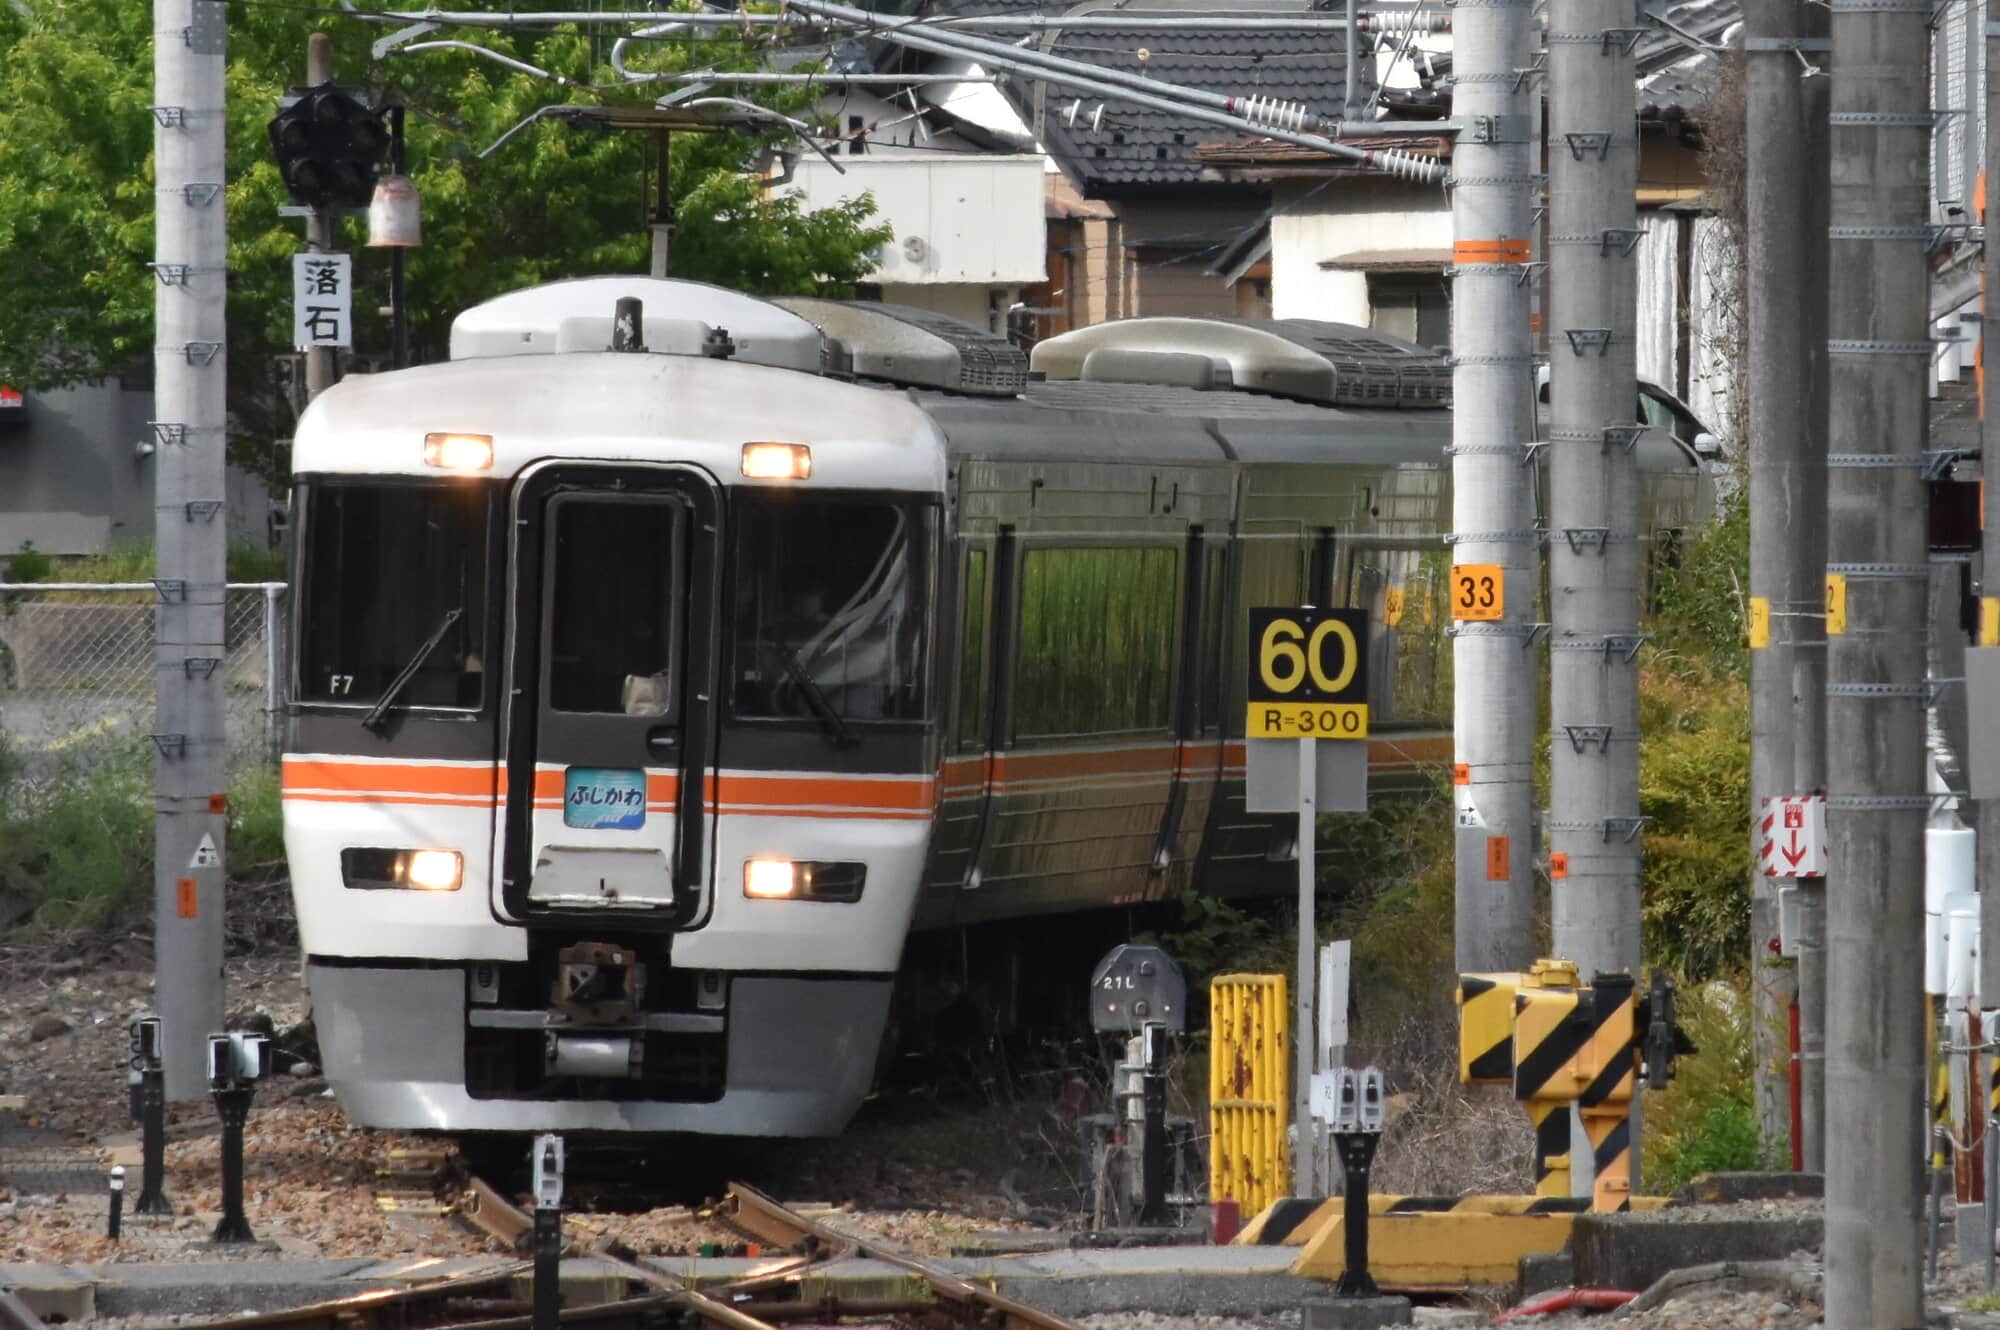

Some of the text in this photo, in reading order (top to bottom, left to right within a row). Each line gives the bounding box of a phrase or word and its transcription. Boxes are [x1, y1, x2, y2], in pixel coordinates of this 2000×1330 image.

[304, 260, 341, 340] 落石
[1460, 576, 1494, 608] 33
[1261, 618, 1357, 693] 60
[331, 674, 354, 695] F7
[1264, 709, 1360, 732] R=300
[570, 785, 643, 806] ふじかわ
[1103, 976, 1135, 990] 21L
